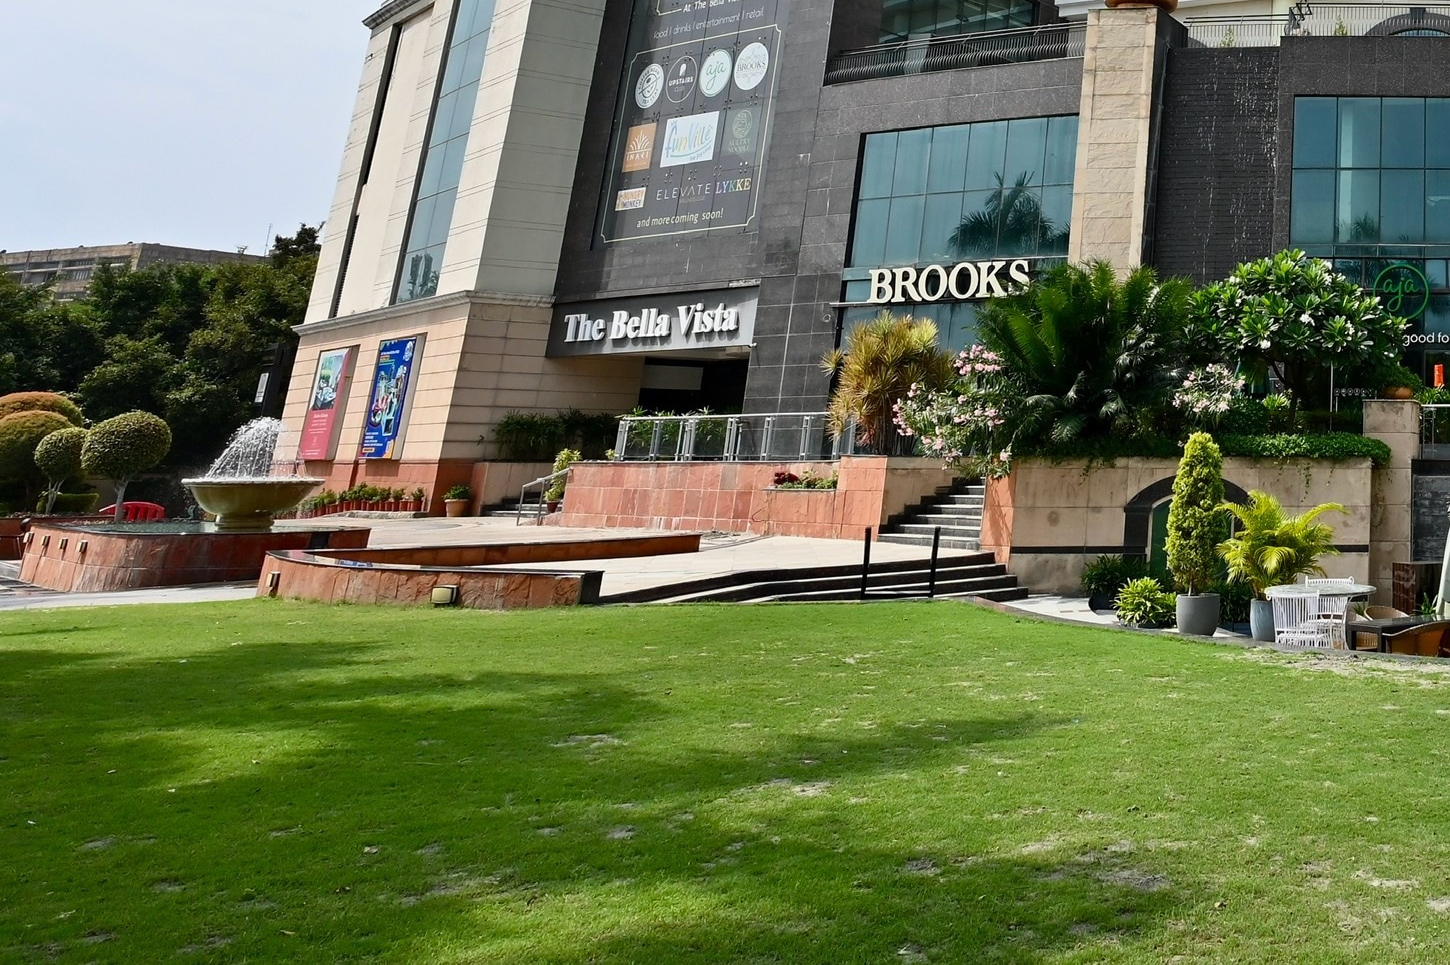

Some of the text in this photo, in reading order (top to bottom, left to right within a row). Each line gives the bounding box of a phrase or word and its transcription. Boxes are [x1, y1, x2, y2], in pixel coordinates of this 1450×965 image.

[683, 4, 691, 13] At
[673, 23, 692, 35] drinks
[695, 14, 740, 30] entertainment
[745, 6, 765, 20] retail
[705, 60, 727, 90] aja
[736, 60, 766, 72] BROOKS
[668, 76, 694, 87] UPSTAIRS
[656, 183, 711, 201] ELEVATE
[715, 178, 751, 194] LYKKE
[637, 207, 724, 228] and more coming soon!
[867, 260, 1031, 304] BROOKS
[1383, 277, 1419, 312] aja
[564, 302, 738, 342] The Bella Vista
[1402, 332, 1435, 347] good
